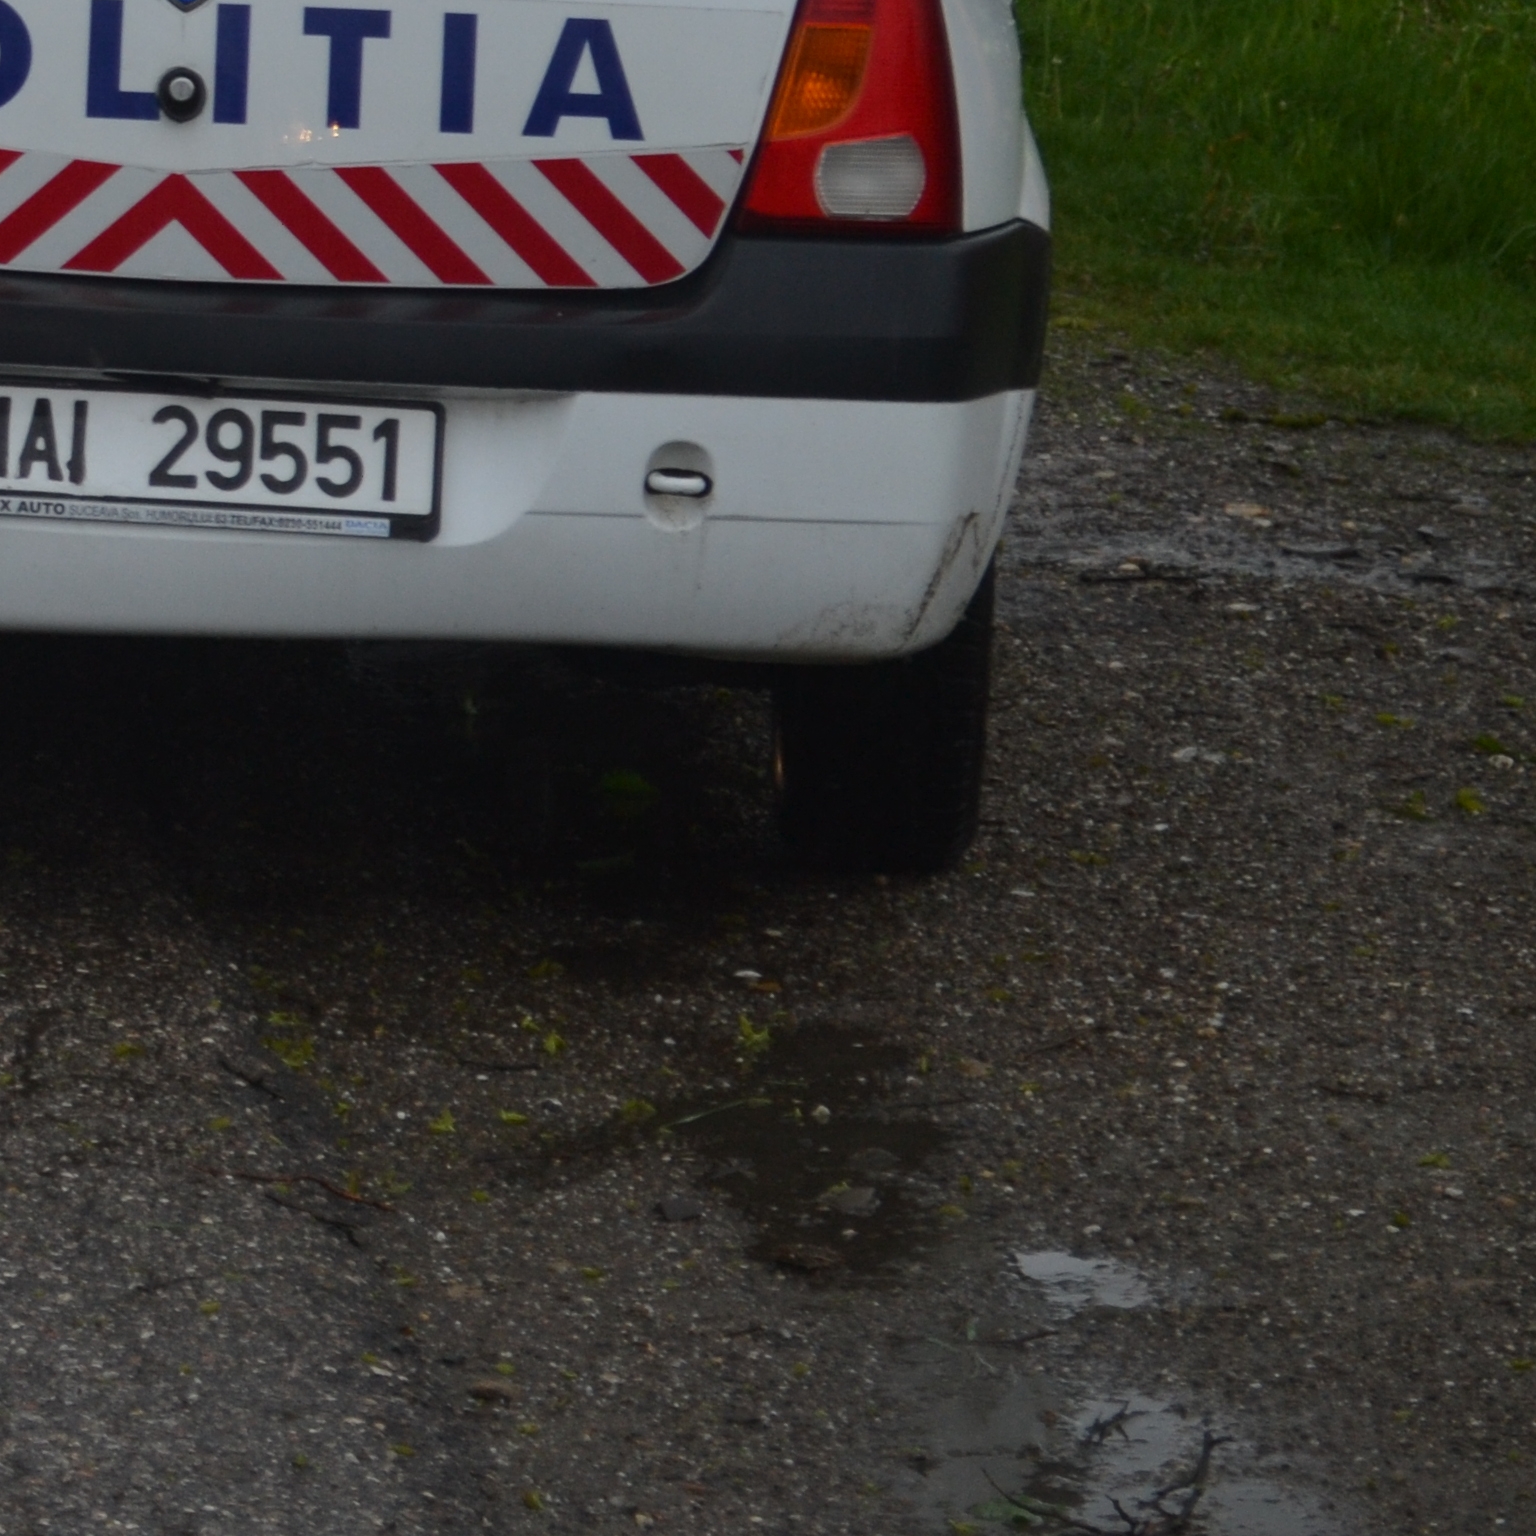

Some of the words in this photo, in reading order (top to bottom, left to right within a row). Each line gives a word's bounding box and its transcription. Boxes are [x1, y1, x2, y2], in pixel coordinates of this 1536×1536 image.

[148, 404, 400, 502] 29551
[17, 499, 65, 515] AUTO
[69, 504, 118, 518] SUCEAVA
